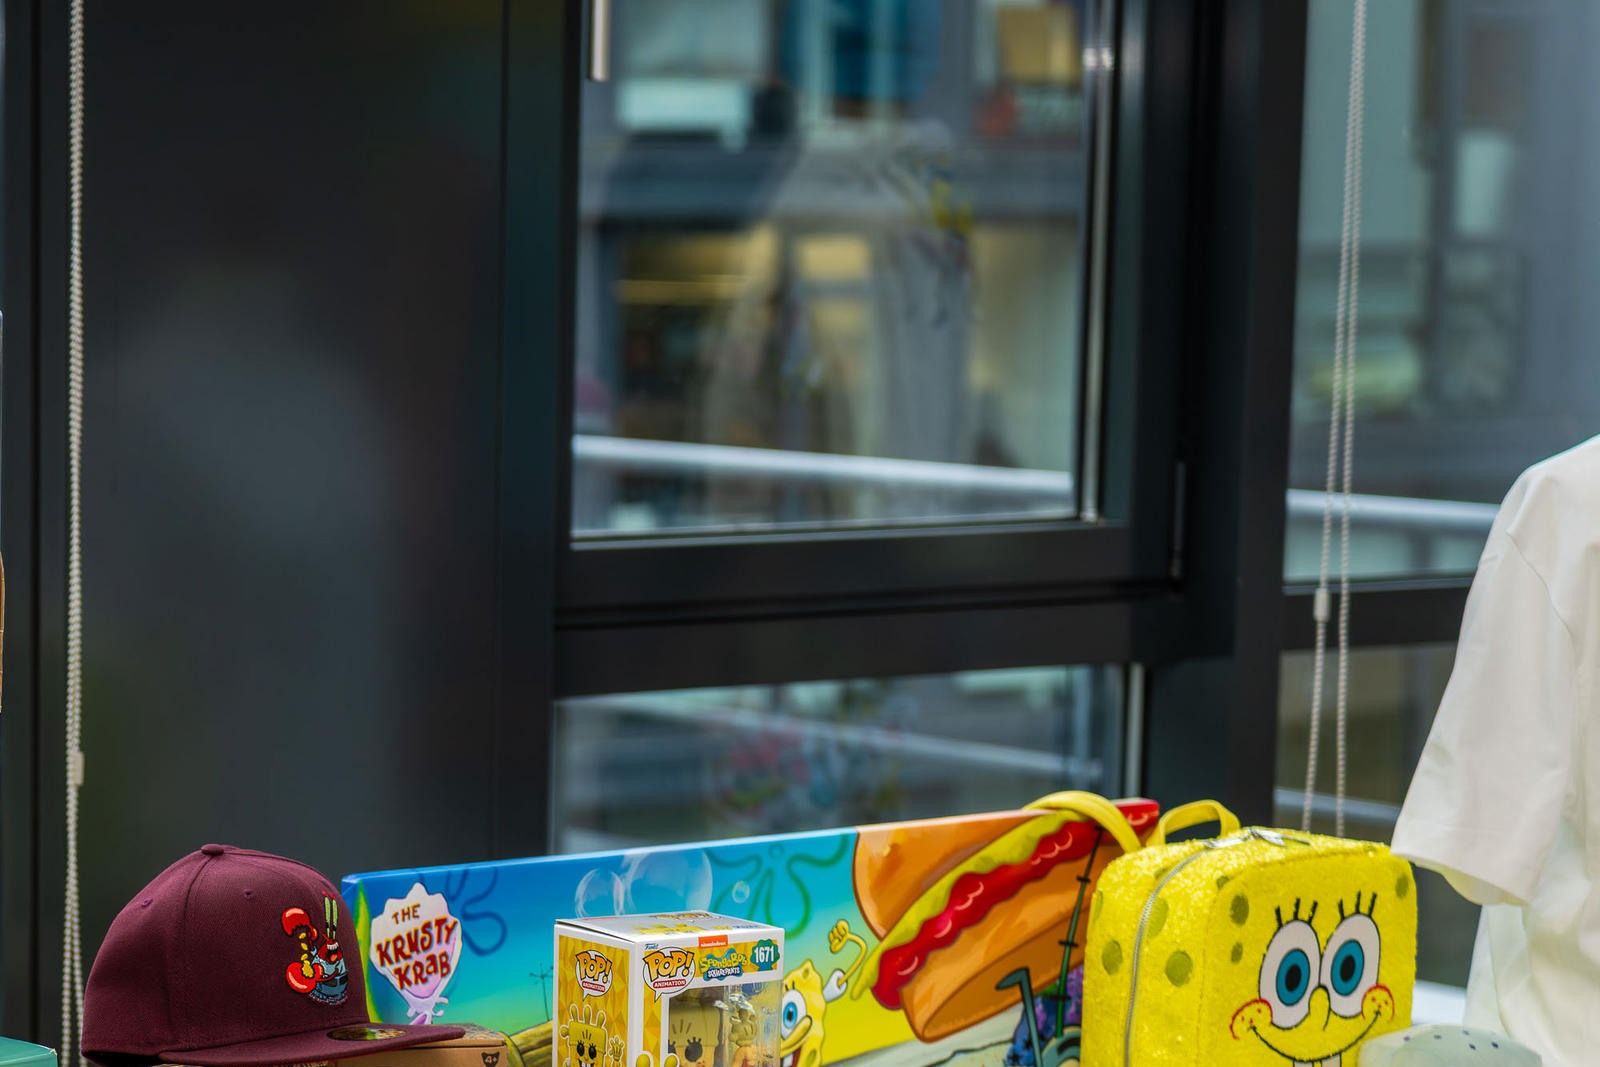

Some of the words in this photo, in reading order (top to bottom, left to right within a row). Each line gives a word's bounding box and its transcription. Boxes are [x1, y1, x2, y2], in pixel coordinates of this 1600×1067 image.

[392, 903, 420, 925] THE
[375, 917, 459, 968] KRUSTY
[644, 948, 694, 981] POP!
[700, 952, 747, 973] SpongeBob
[754, 946, 774, 963] 1671
[576, 951, 612, 985] POP!
[707, 967, 741, 978] SQUAREPANTS
[653, 979, 687, 989] ANIMATION
